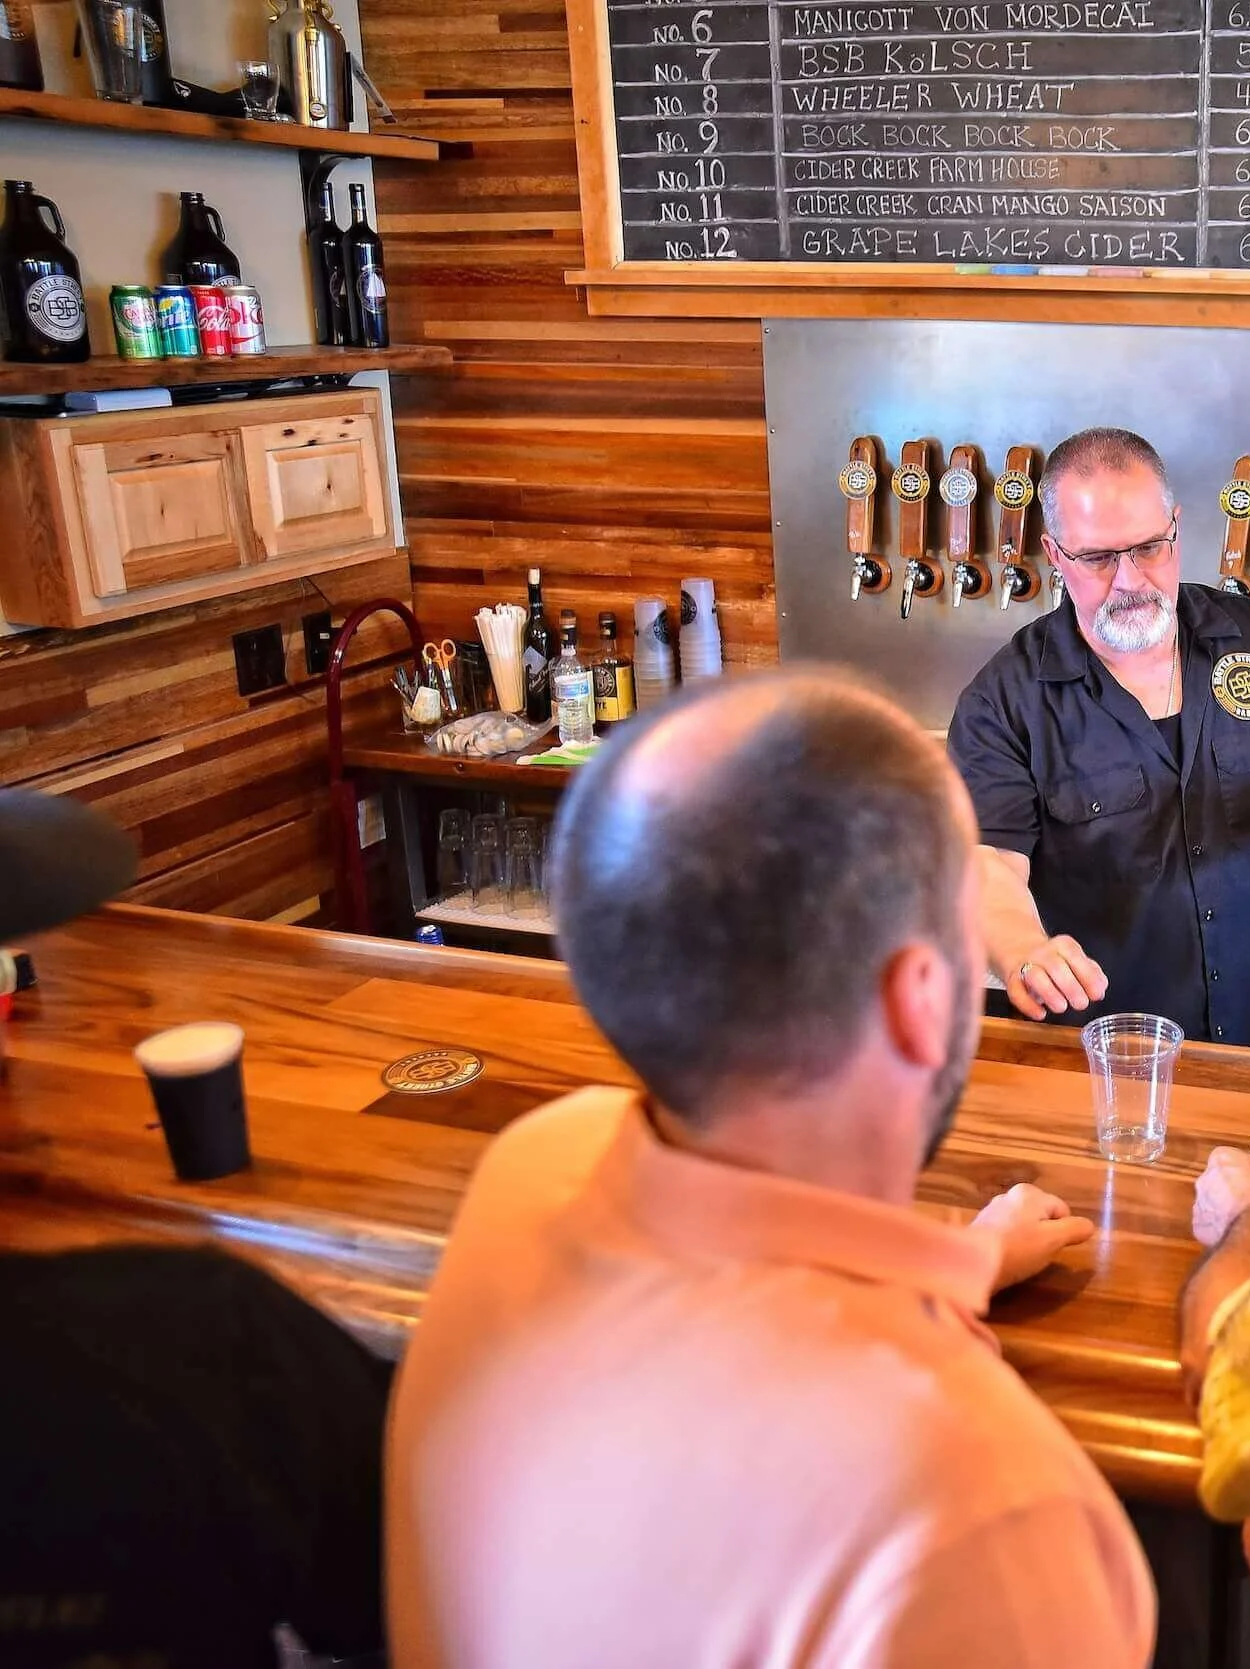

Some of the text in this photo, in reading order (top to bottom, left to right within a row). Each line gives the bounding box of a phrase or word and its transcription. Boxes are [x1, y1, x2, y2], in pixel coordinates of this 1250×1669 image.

[691, 10, 713, 43] 6
[935, 5, 989, 31] VON
[1006, 1, 1154, 28] MORDECAI
[695, 49, 720, 82] 7
[799, 43, 864, 77] BSB
[702, 84, 718, 118] 8
[792, 82, 1074, 112] WHEELER WHEAT
[700, 121, 718, 153] 9
[802, 124, 1121, 151] BOCK BOCK BOCK BOCK
[695, 159, 726, 190] 10
[794, 157, 1060, 182] CIDER CREEK FARM HOUSE
[700, 192, 726, 221] 11
[796, 192, 1167, 217] CIDER CREEK CRAN MANGO SAISON
[700, 227, 737, 258] 12
[802, 227, 1185, 261] GRAPE LAKES CIDER
